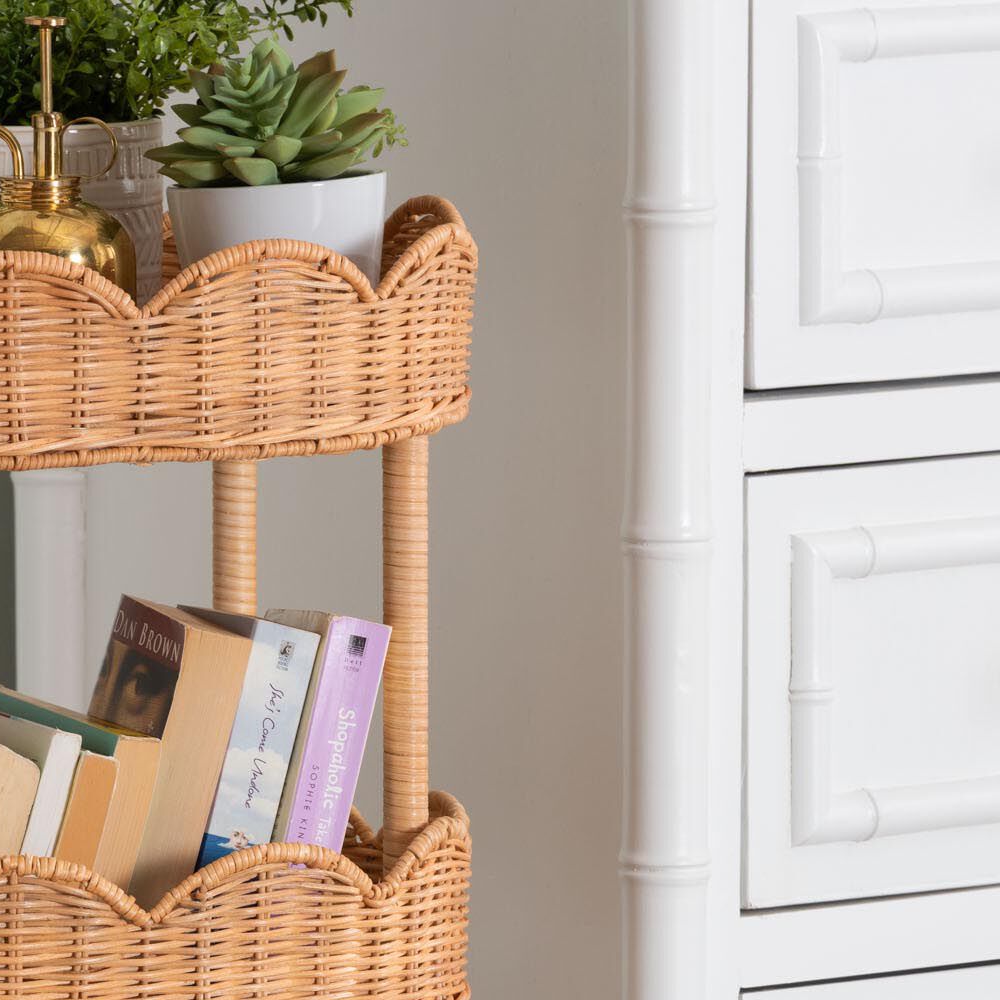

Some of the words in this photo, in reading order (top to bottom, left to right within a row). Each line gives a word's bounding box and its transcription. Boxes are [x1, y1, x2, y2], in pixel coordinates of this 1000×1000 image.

[113, 609, 138, 640] DAN
[138, 622, 181, 663] BROWN
[264, 682, 285, 713] She's
[258, 717, 276, 752] Come
[323, 707, 357, 809] Shopaholic
[244, 758, 267, 809] Undone
[303, 764, 320, 811] SOPHIE
[297, 818, 308, 844] KIN
